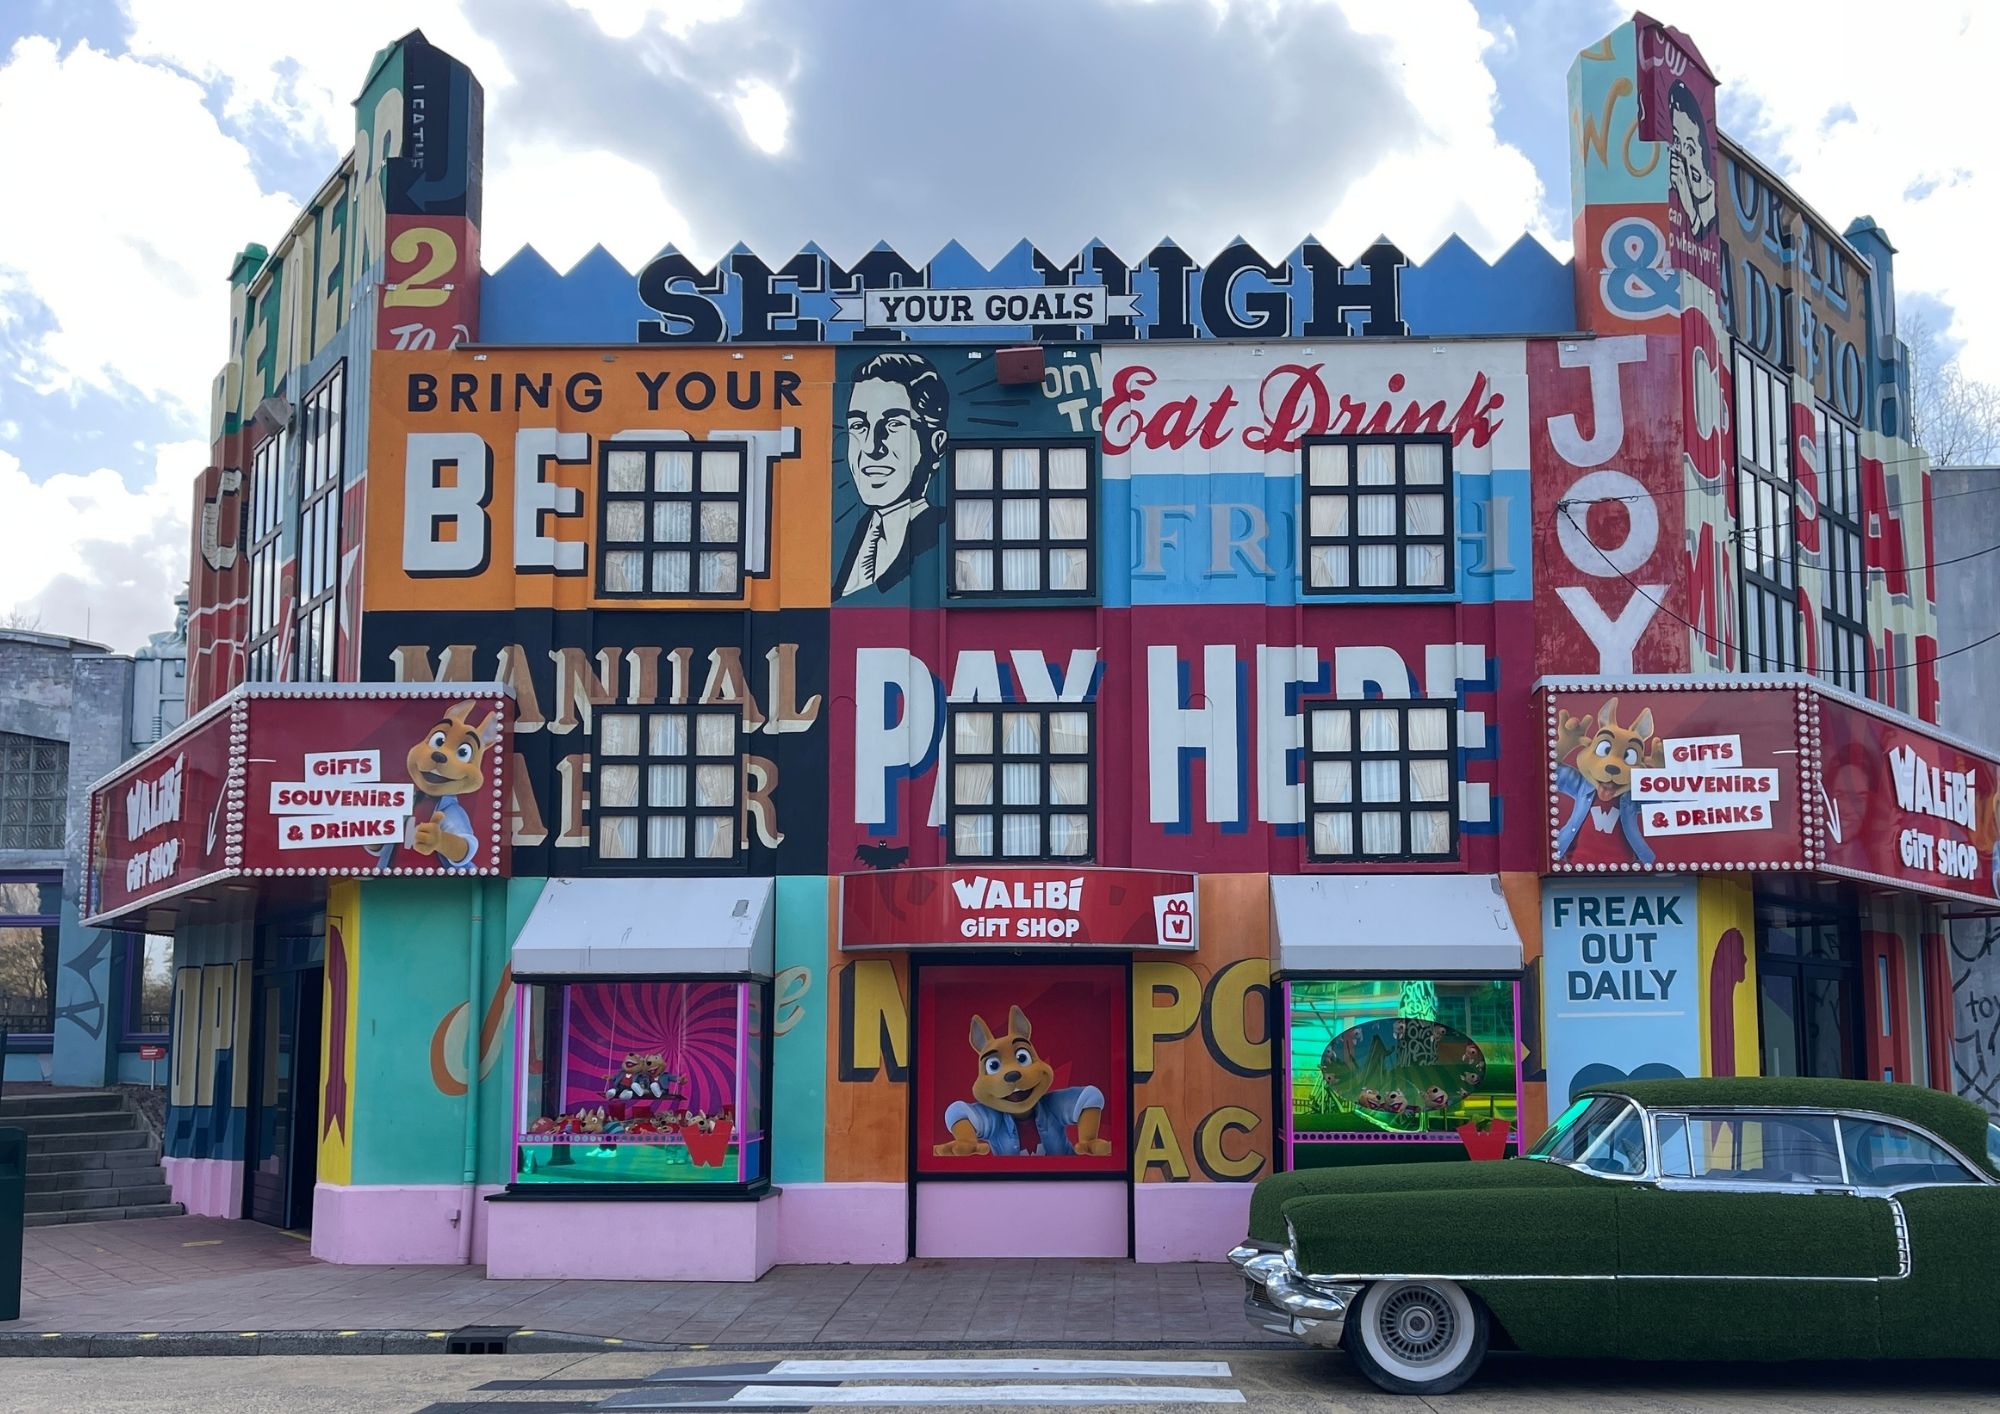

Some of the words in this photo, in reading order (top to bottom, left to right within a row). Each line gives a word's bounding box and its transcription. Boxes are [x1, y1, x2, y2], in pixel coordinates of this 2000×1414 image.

[383, 227, 458, 308] 2
[638, 248, 930, 341] SET
[1032, 243, 1409, 340] HIGH
[880, 295, 974, 323] YOUR
[985, 292, 1093, 322] GOALS
[408, 372, 603, 413] BRING
[636, 370, 802, 411] YOUR
[1100, 366, 1239, 456] Eat
[1242, 363, 1505, 455] Drink
[402, 427, 801, 579] BET
[1547, 334, 1671, 675] JOY
[1131, 496, 1517, 582] FRH
[287, 825, 304, 841] &
[1651, 812, 1669, 828] &
[149, 838, 179, 884] SHOP
[1937, 838, 1978, 880] SHOP
[1016, 918, 1080, 938] SHOP
[1553, 895, 1684, 928] FREAK
[1581, 932, 1658, 964] OUT
[1567, 969, 1678, 1001] DAILY
